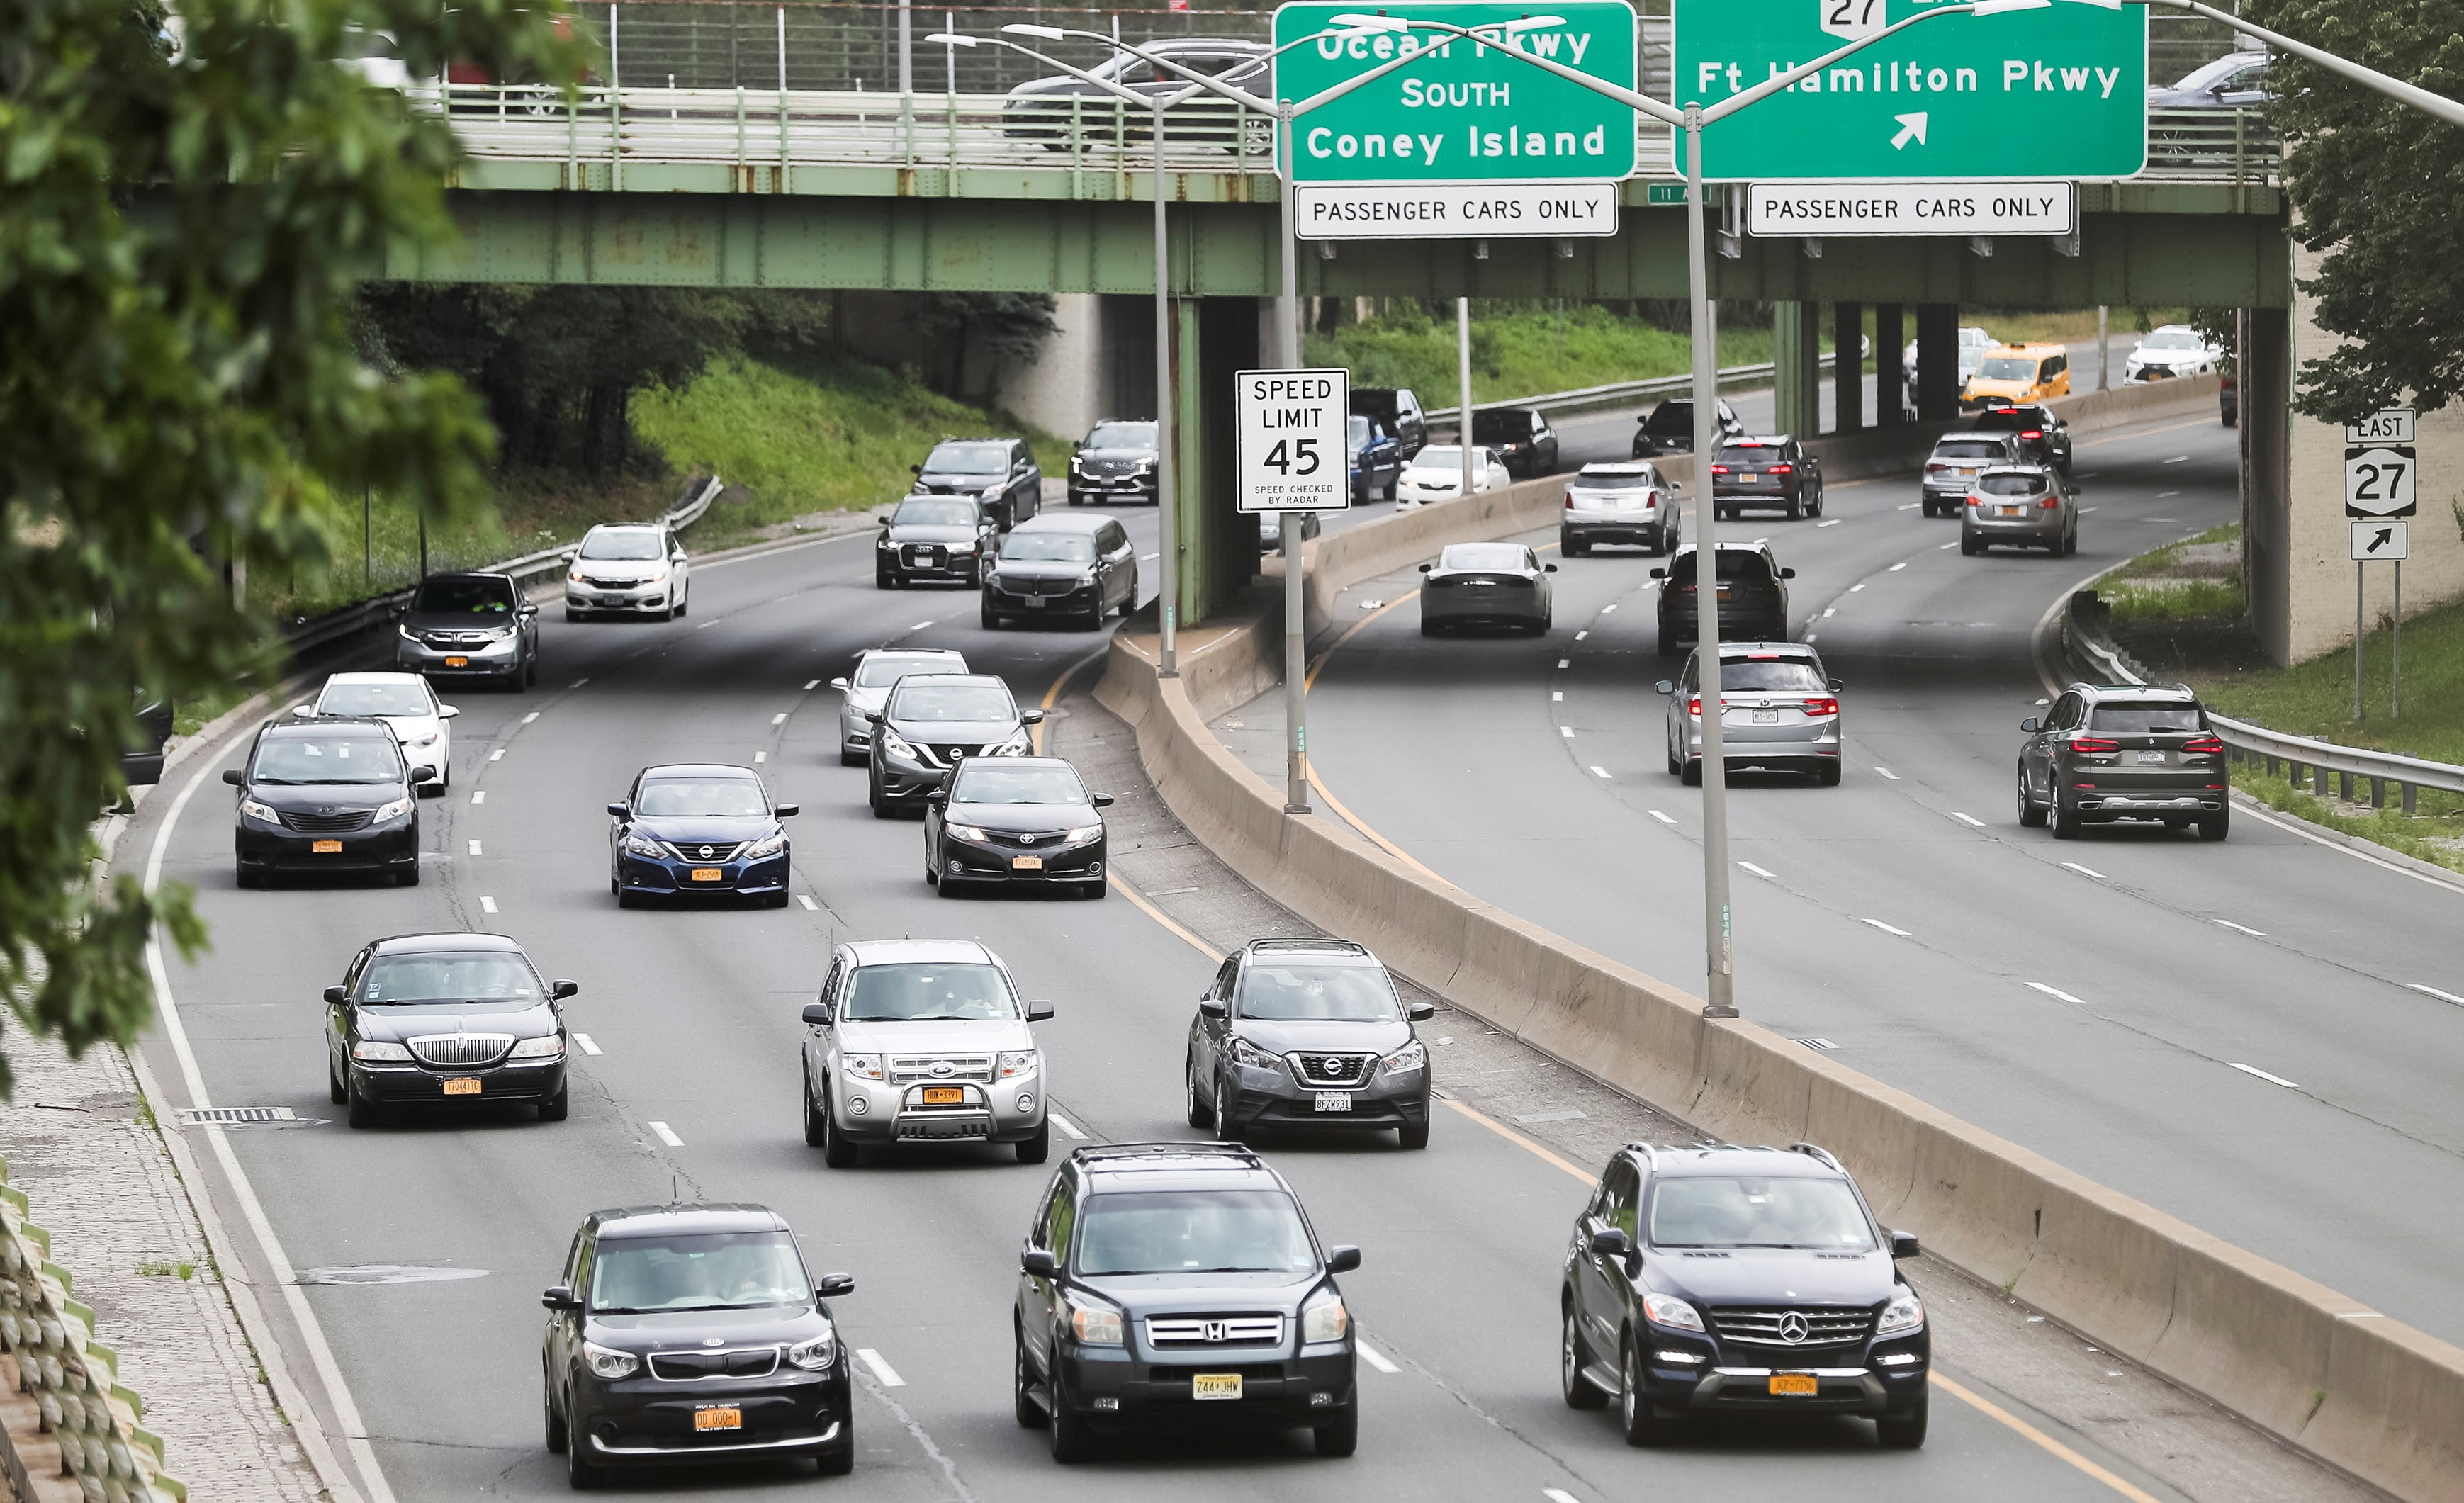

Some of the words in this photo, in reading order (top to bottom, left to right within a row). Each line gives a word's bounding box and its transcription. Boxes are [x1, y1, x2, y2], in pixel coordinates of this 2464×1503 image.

[1317, 28, 1450, 60] Ocean
[1699, 62, 1742, 94] Ft
[1769, 60, 1977, 93] Hamilton
[2003, 60, 2120, 99] Pkwy
[1307, 127, 1444, 165] Coney
[1470, 124, 1604, 157] Island
[1314, 202, 1446, 220] PASSENGER
[1463, 201, 1521, 219] CARS
[1539, 199, 1599, 218] ONLY
[1765, 200, 1898, 218] PASSENGER
[1915, 199, 1976, 217] CARS
[1993, 198, 2054, 217] ONLY
[1254, 379, 1332, 400] SPEED
[1263, 408, 1322, 429] LIMIT
[2358, 417, 2402, 437] EAST
[1264, 439, 1320, 475] 45
[1255, 485, 1285, 494] SPEED
[1290, 485, 1333, 493] CHECKED
[2355, 463, 2406, 500] 27
[1286, 495, 1319, 504] RADAR
